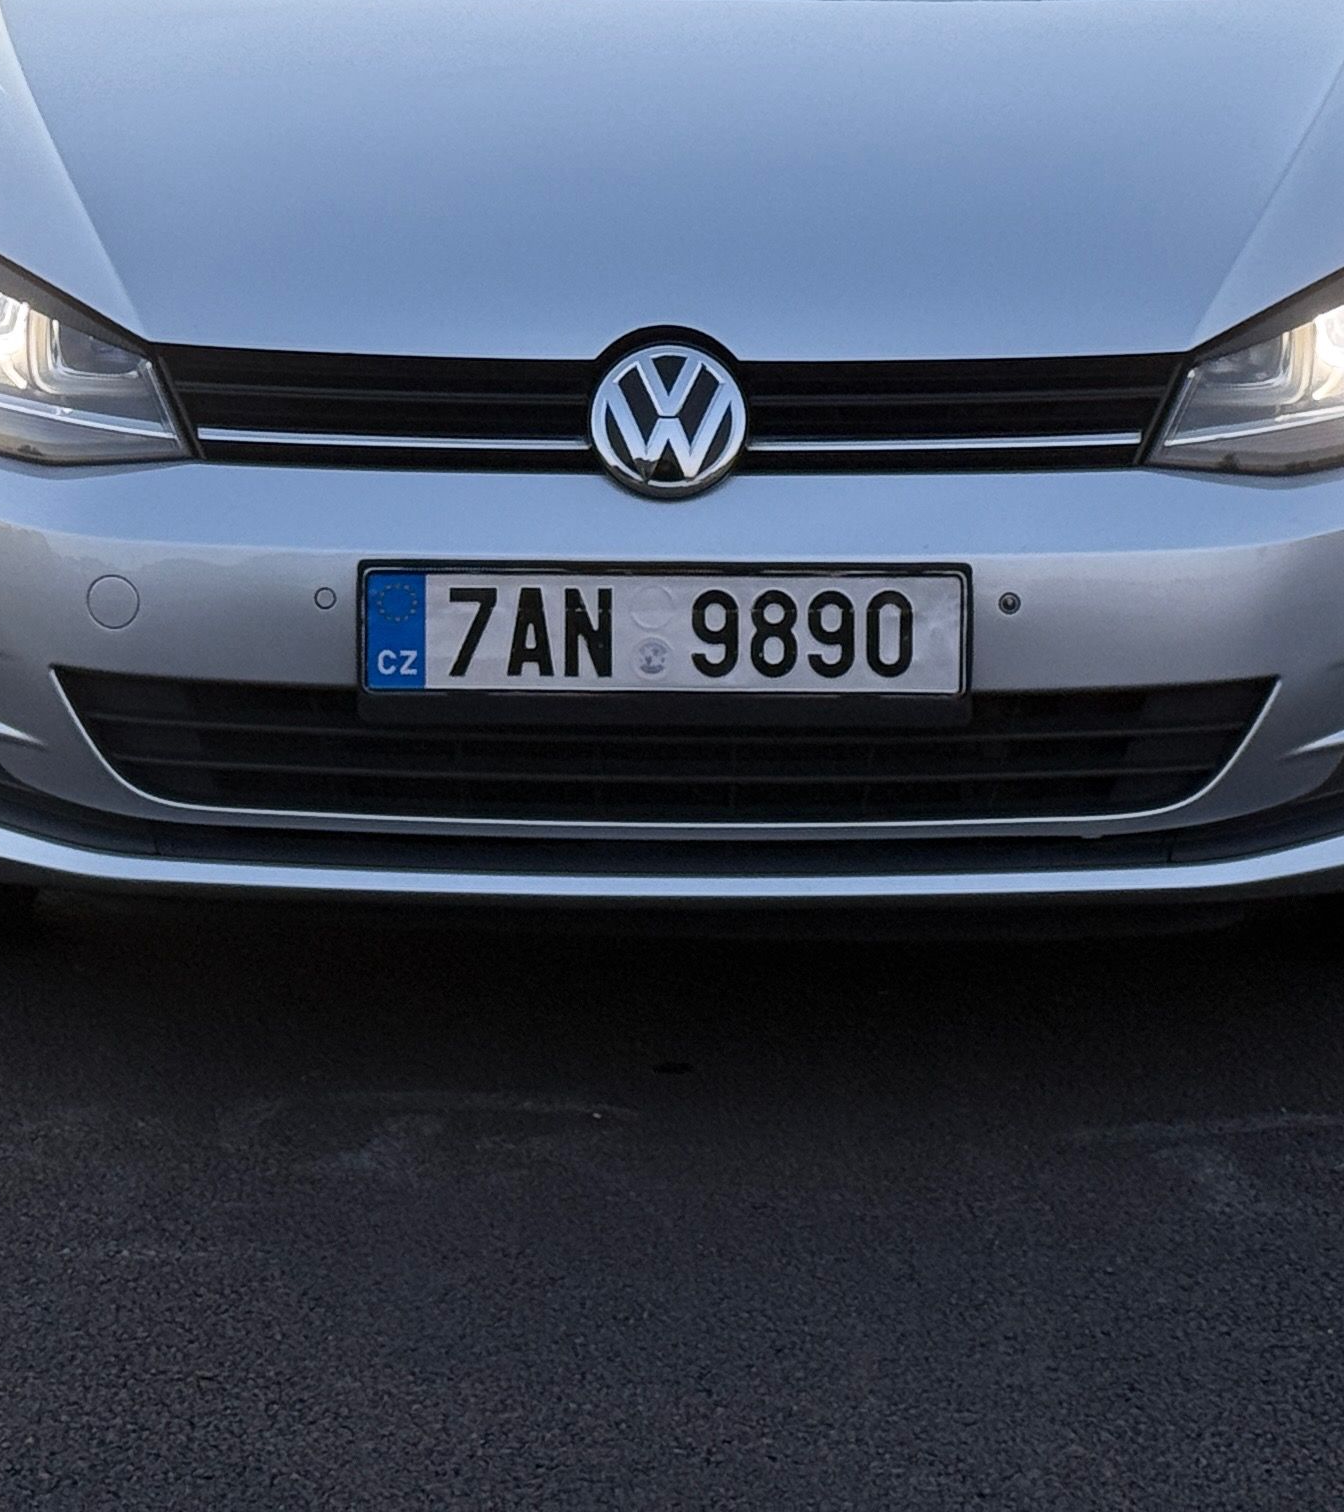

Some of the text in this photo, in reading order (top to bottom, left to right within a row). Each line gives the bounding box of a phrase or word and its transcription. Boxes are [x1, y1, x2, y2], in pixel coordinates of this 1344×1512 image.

[595, 346, 742, 486] VW
[377, 649, 418, 676] CZ
[448, 587, 914, 680] 7AN 9890
